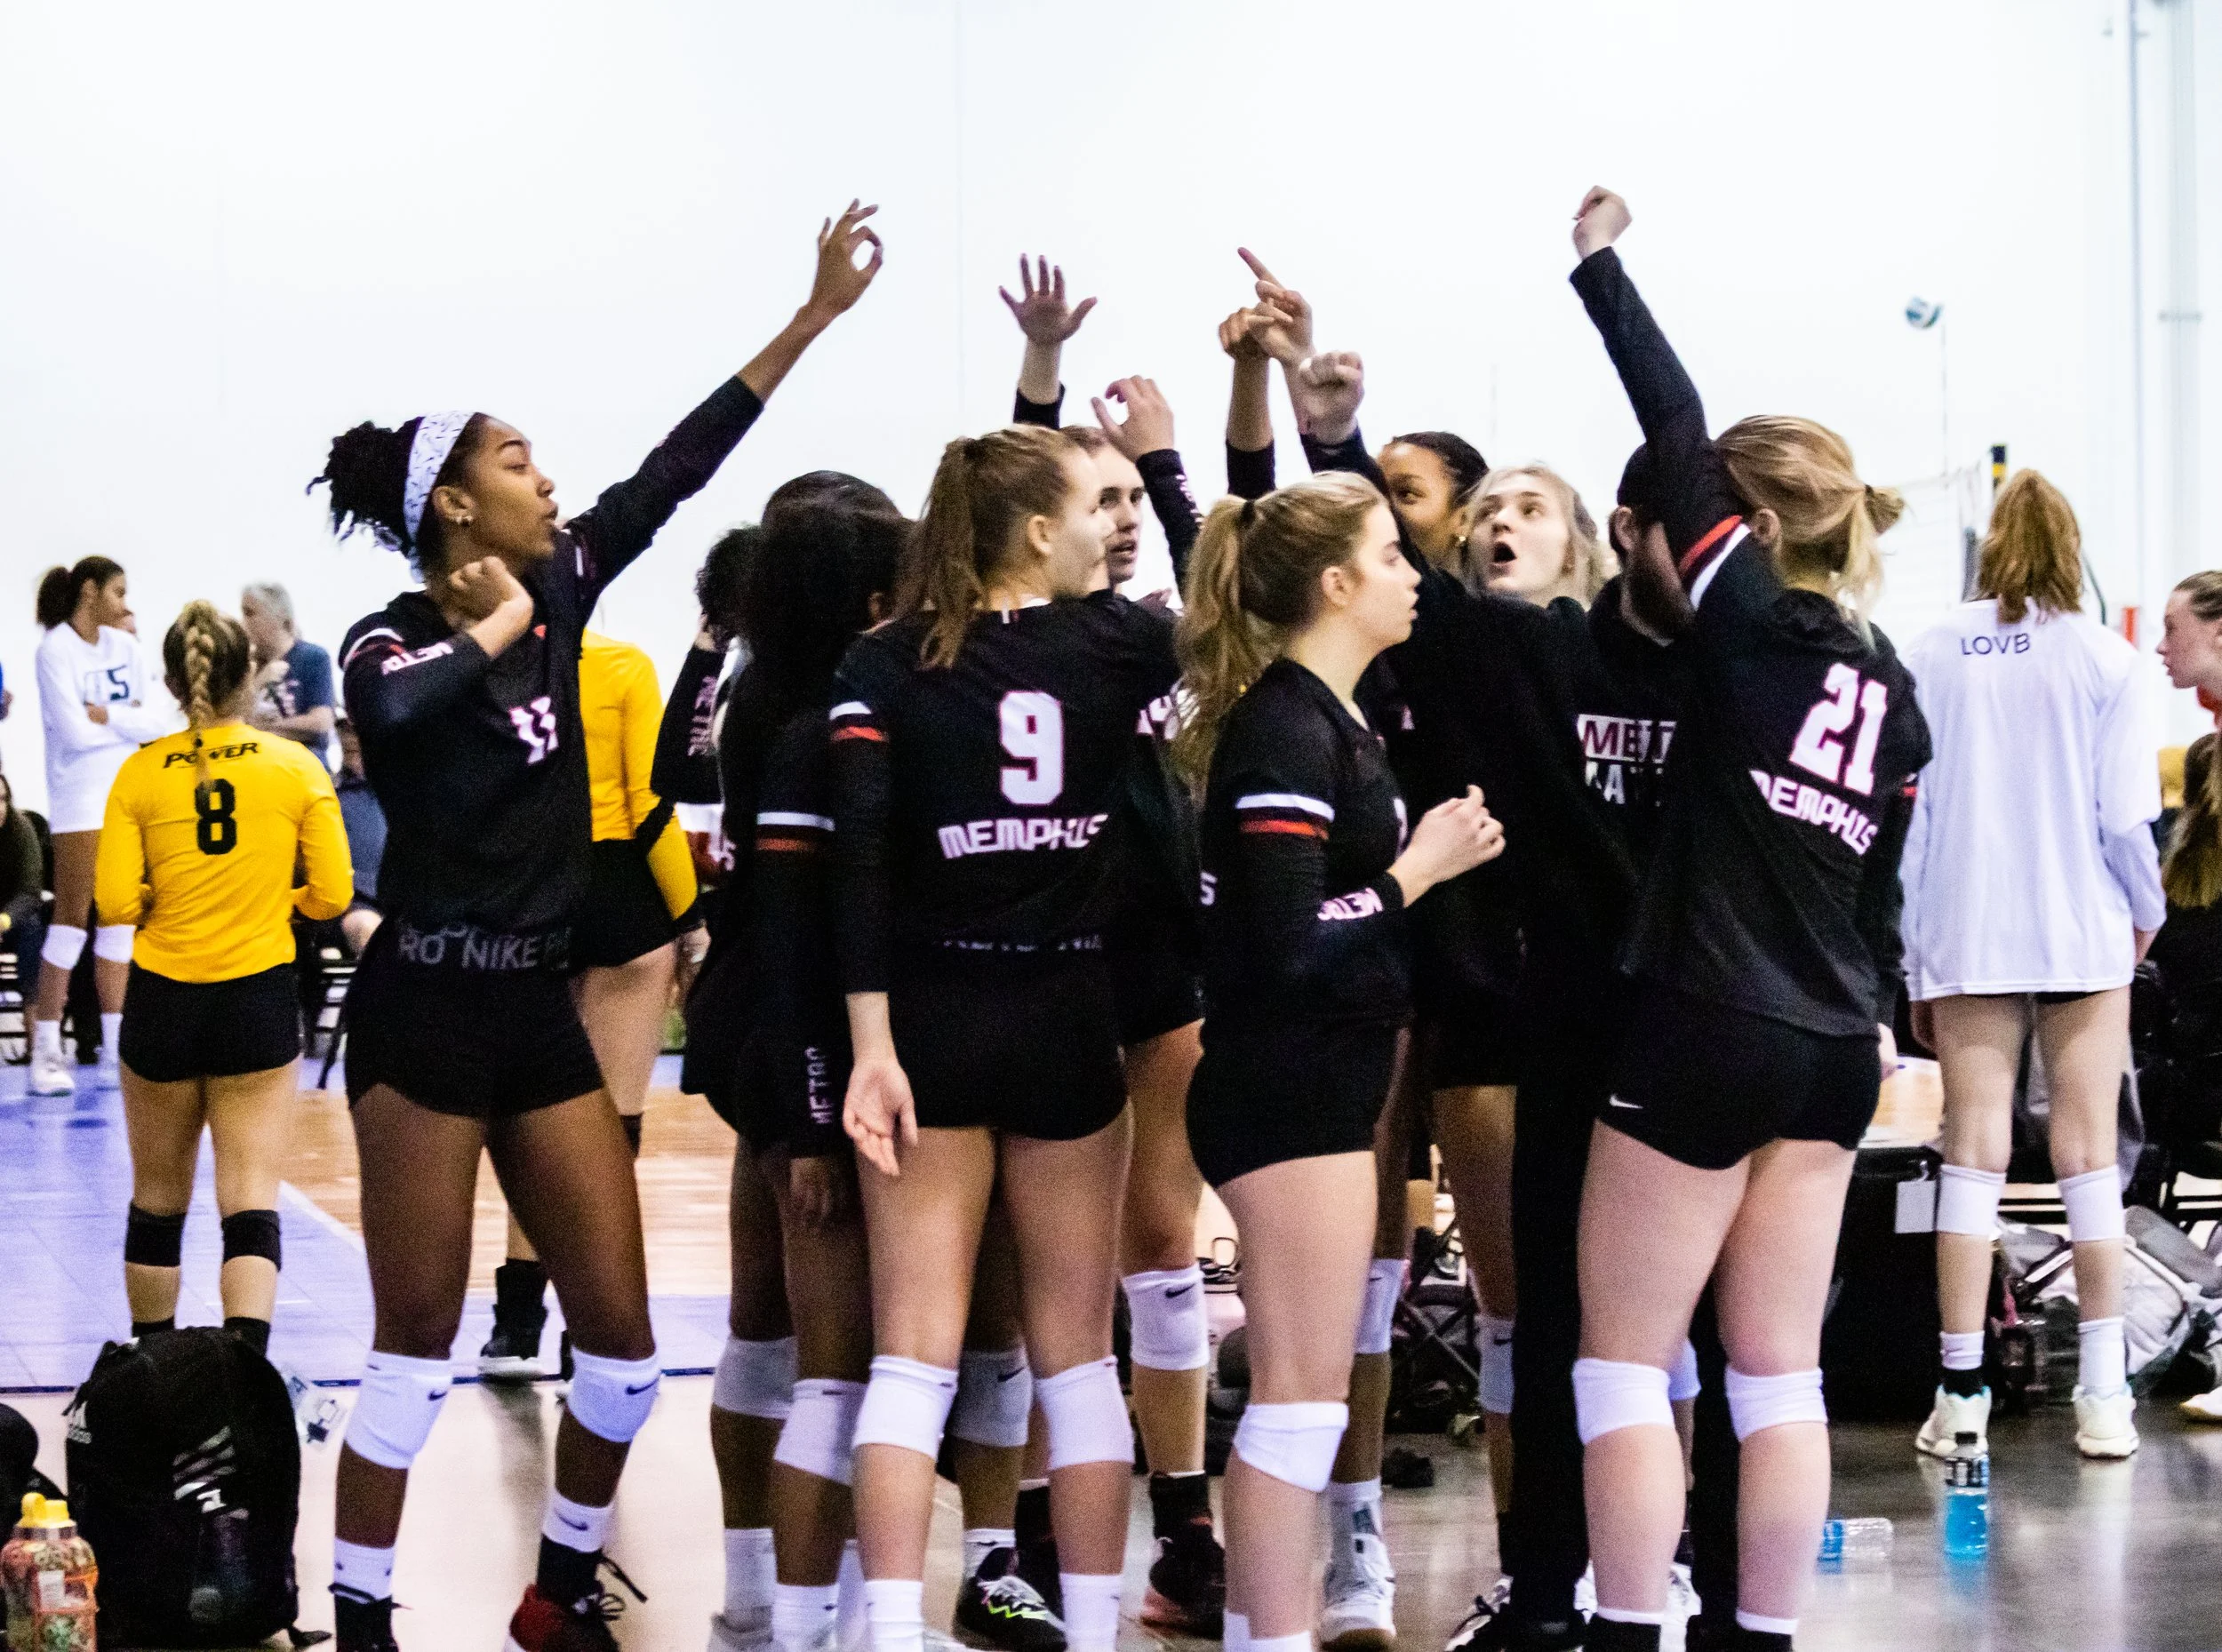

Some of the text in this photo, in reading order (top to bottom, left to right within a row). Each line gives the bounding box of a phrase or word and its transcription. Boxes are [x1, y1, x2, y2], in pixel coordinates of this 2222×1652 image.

[1961, 633, 2031, 655] LOVB
[107, 665, 130, 701] 5
[998, 690, 1064, 804] 9
[1788, 663, 1888, 797] 21
[163, 742, 259, 769] POER
[195, 778, 236, 856] 8
[938, 812, 1108, 859] MEMPHIS
[460, 926, 542, 970] NIKE
